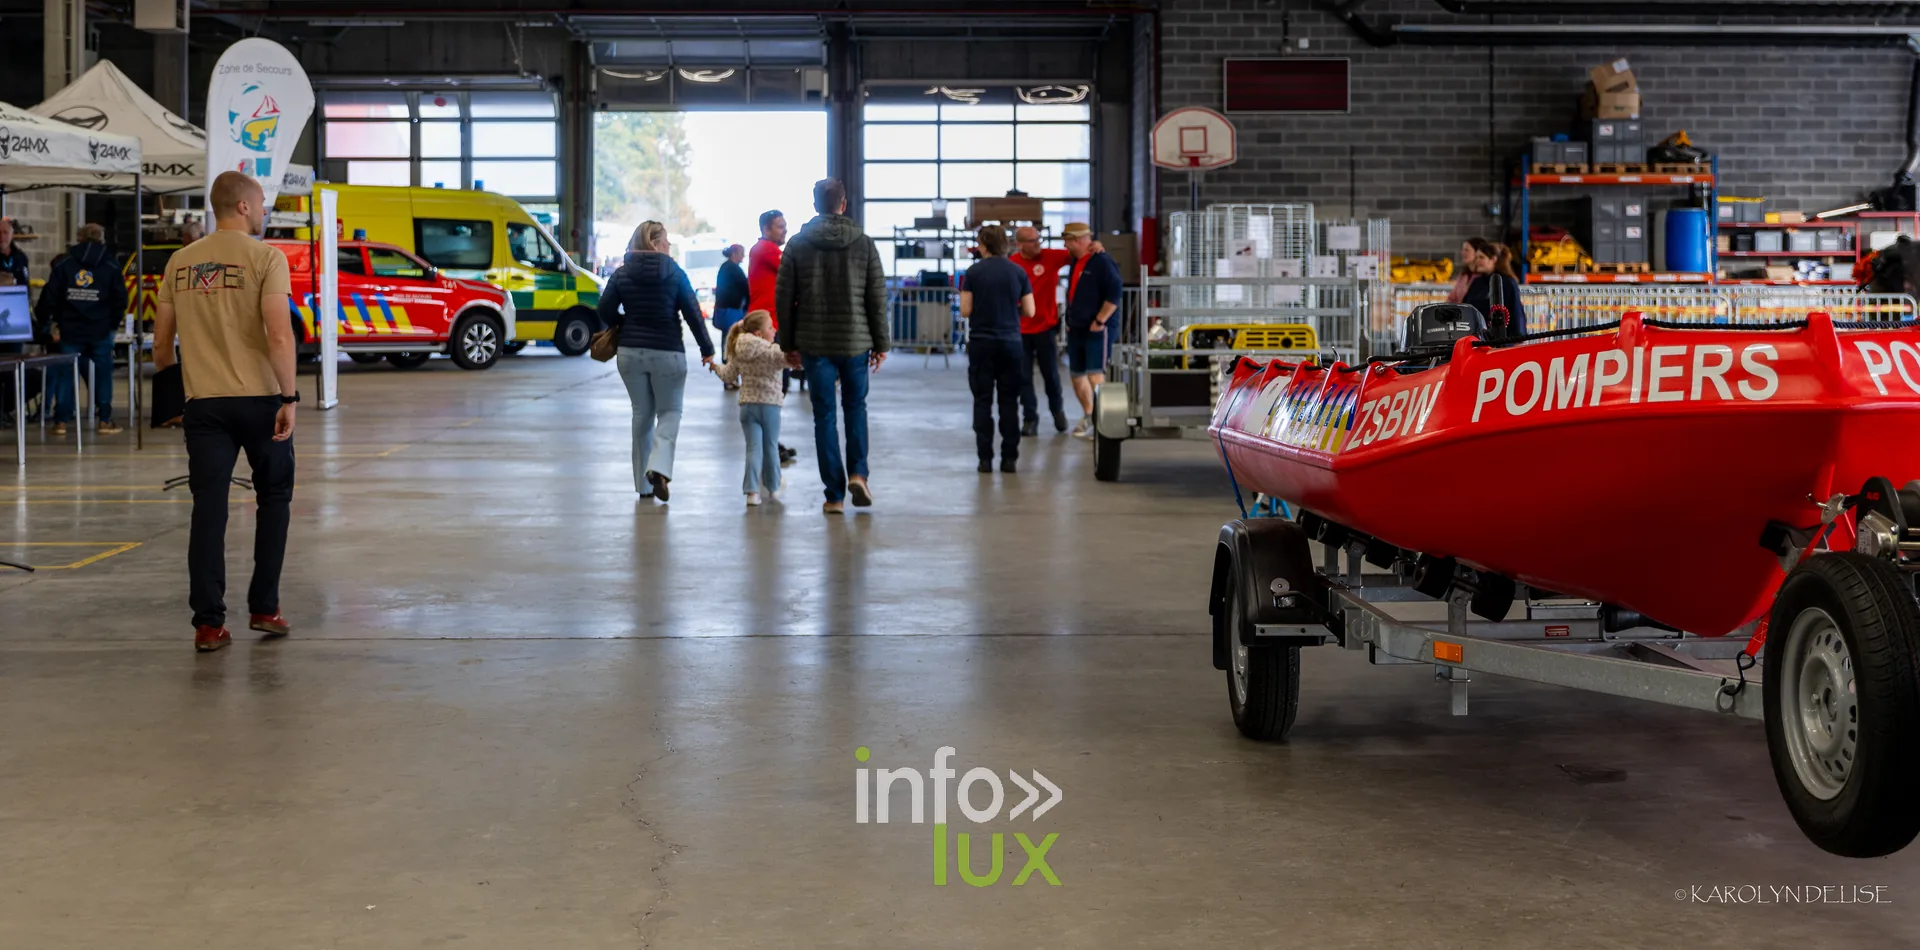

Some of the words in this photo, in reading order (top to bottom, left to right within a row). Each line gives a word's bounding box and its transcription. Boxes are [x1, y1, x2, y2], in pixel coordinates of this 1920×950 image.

[219, 64, 240, 74] Zone
[243, 64, 253, 73] de
[256, 63, 292, 75] Secours
[12, 136, 50, 154] 24MX
[100, 144, 131, 160] 24MX
[1446, 321, 1471, 331] 15
[1853, 340, 1920, 396] PO
[1471, 343, 1779, 423] POMPIERS
[1346, 381, 1443, 451] ZSBW
